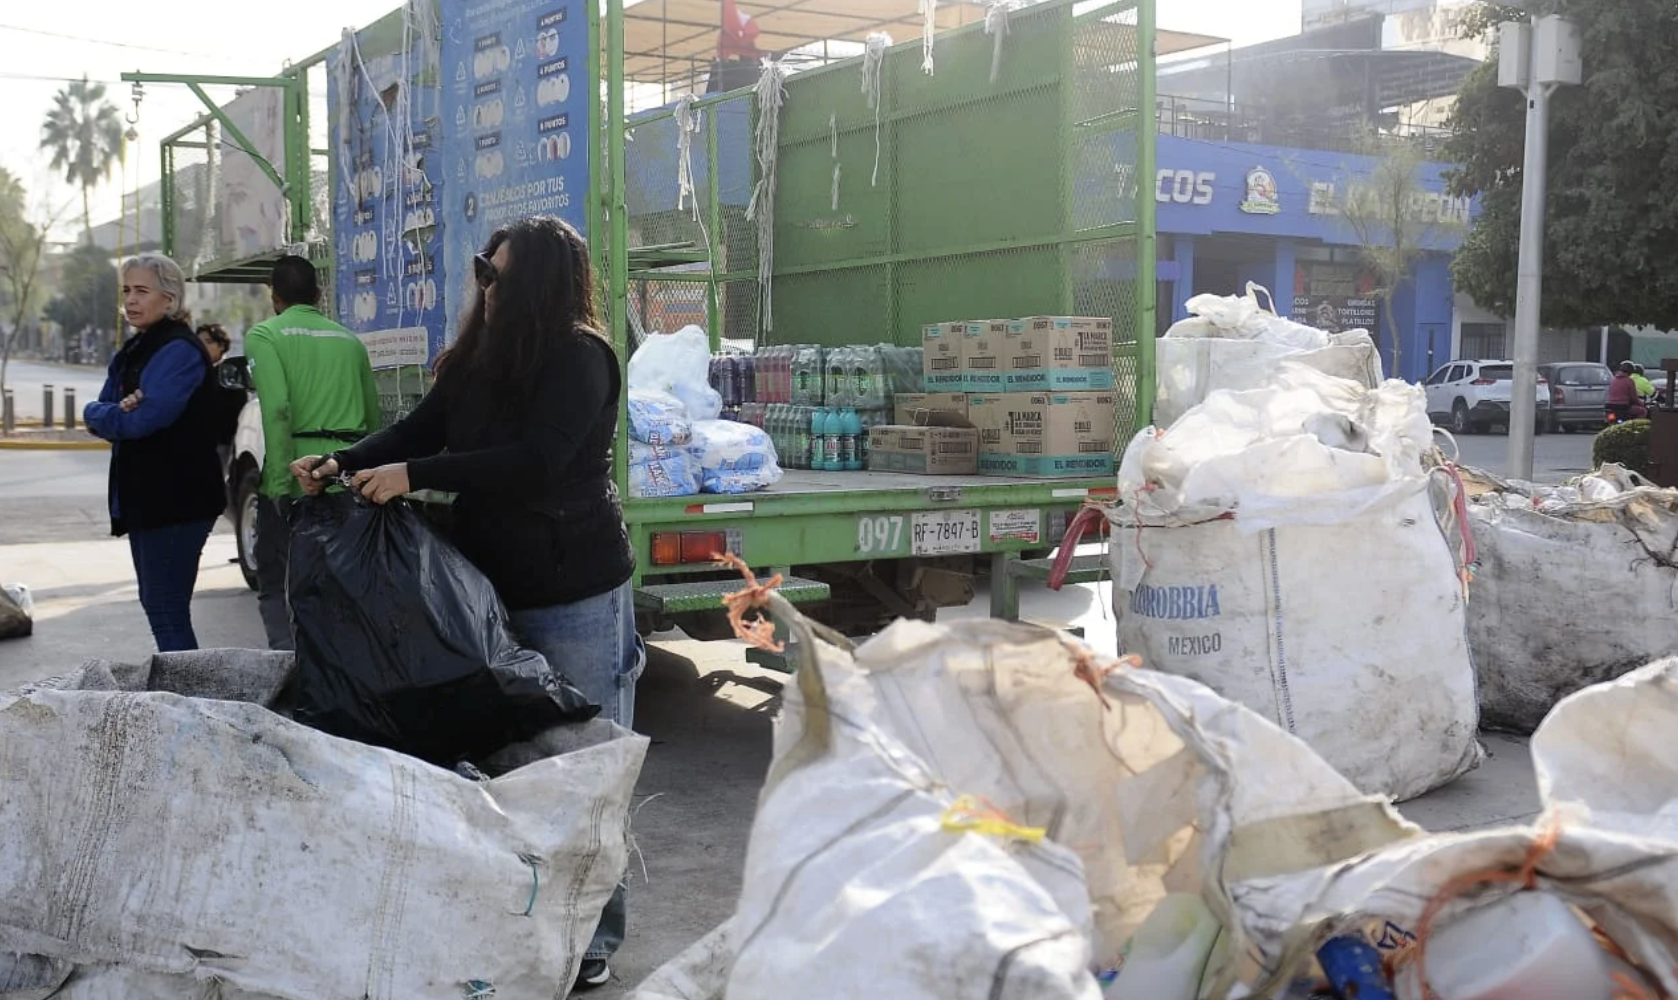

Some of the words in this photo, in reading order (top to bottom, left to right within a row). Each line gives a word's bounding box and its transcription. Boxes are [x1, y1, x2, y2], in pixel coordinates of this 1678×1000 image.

[545, 60, 566, 73] PUNTOS
[527, 180, 546, 199] POR
[547, 176, 565, 193] TUS
[1309, 182, 1342, 214] EL
[466, 197, 474, 217] 2
[1054, 461, 1063, 469] EL
[1066, 459, 1107, 468] RENDIDOR
[859, 516, 903, 551] 097
[914, 520, 979, 543] RF-7847-B
[1168, 632, 1222, 656] MEXICO
